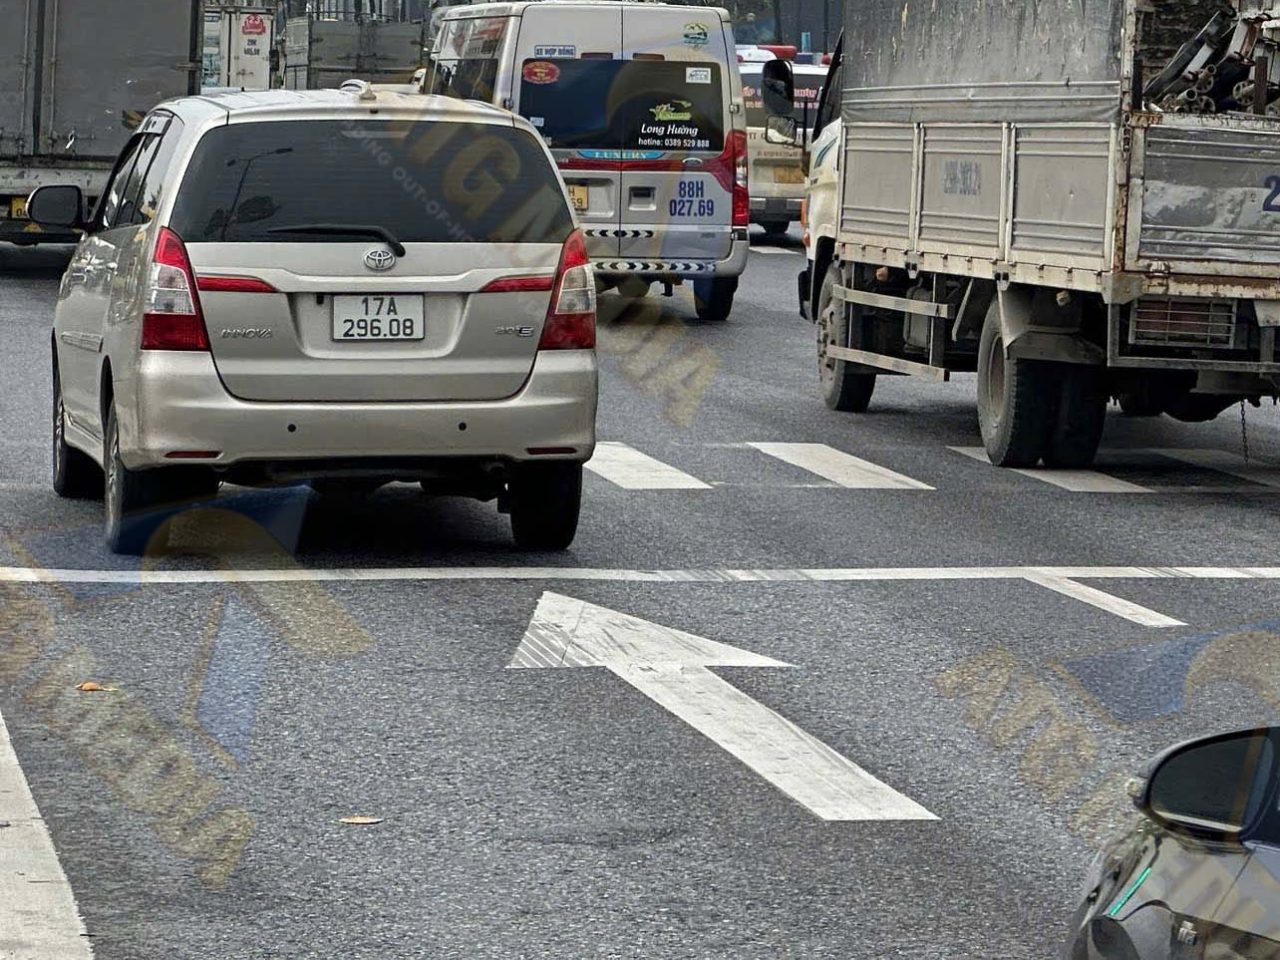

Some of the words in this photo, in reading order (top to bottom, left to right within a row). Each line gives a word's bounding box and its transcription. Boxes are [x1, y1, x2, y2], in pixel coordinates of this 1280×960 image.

[641, 123, 665, 136] Long
[594, 151, 650, 160] LUXURY
[679, 180, 704, 198] 88H
[669, 198, 714, 217] 027.69
[361, 295, 398, 317] 17A
[343, 319, 414, 338] 296.08
